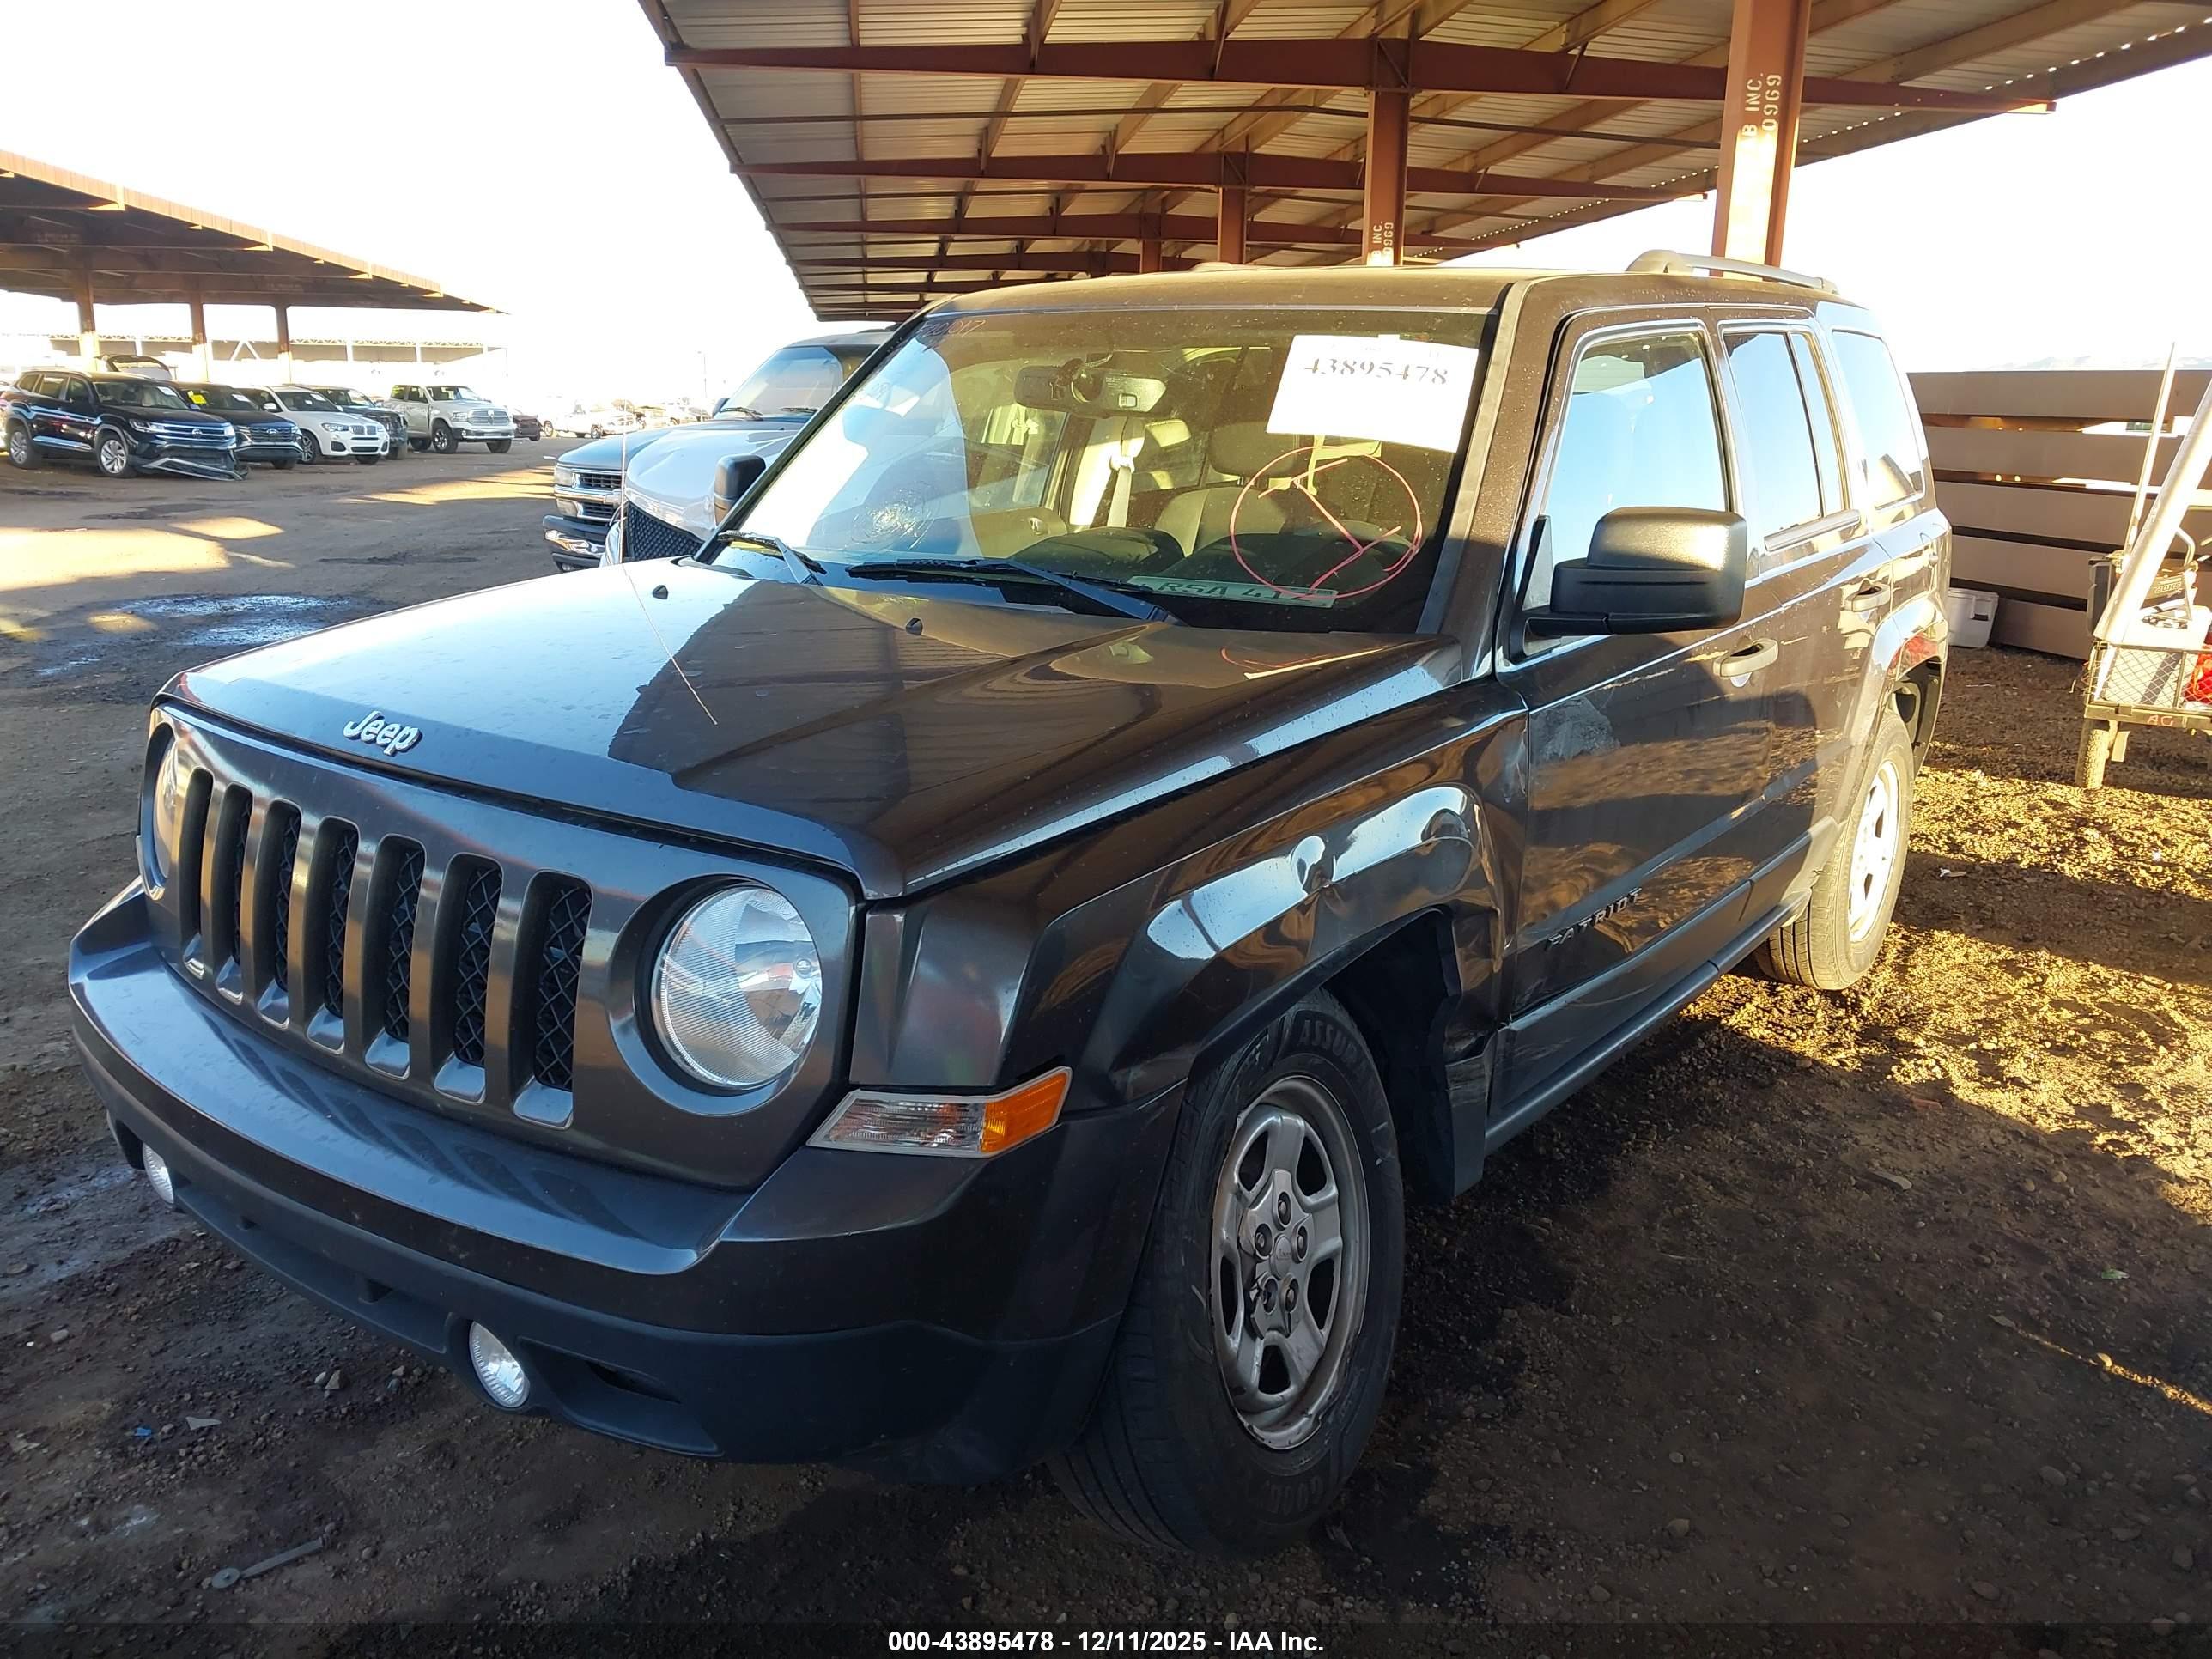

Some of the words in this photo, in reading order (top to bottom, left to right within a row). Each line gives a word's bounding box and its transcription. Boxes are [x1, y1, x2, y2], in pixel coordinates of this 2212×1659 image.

[1744, 73, 1763, 112] INC.
[1761, 74, 1782, 131] 0969
[1372, 221, 1383, 244] INC.
[1304, 357, 1449, 386] 43895478
[1158, 581, 1228, 596] RSA
[343, 711, 422, 756] Jeep
